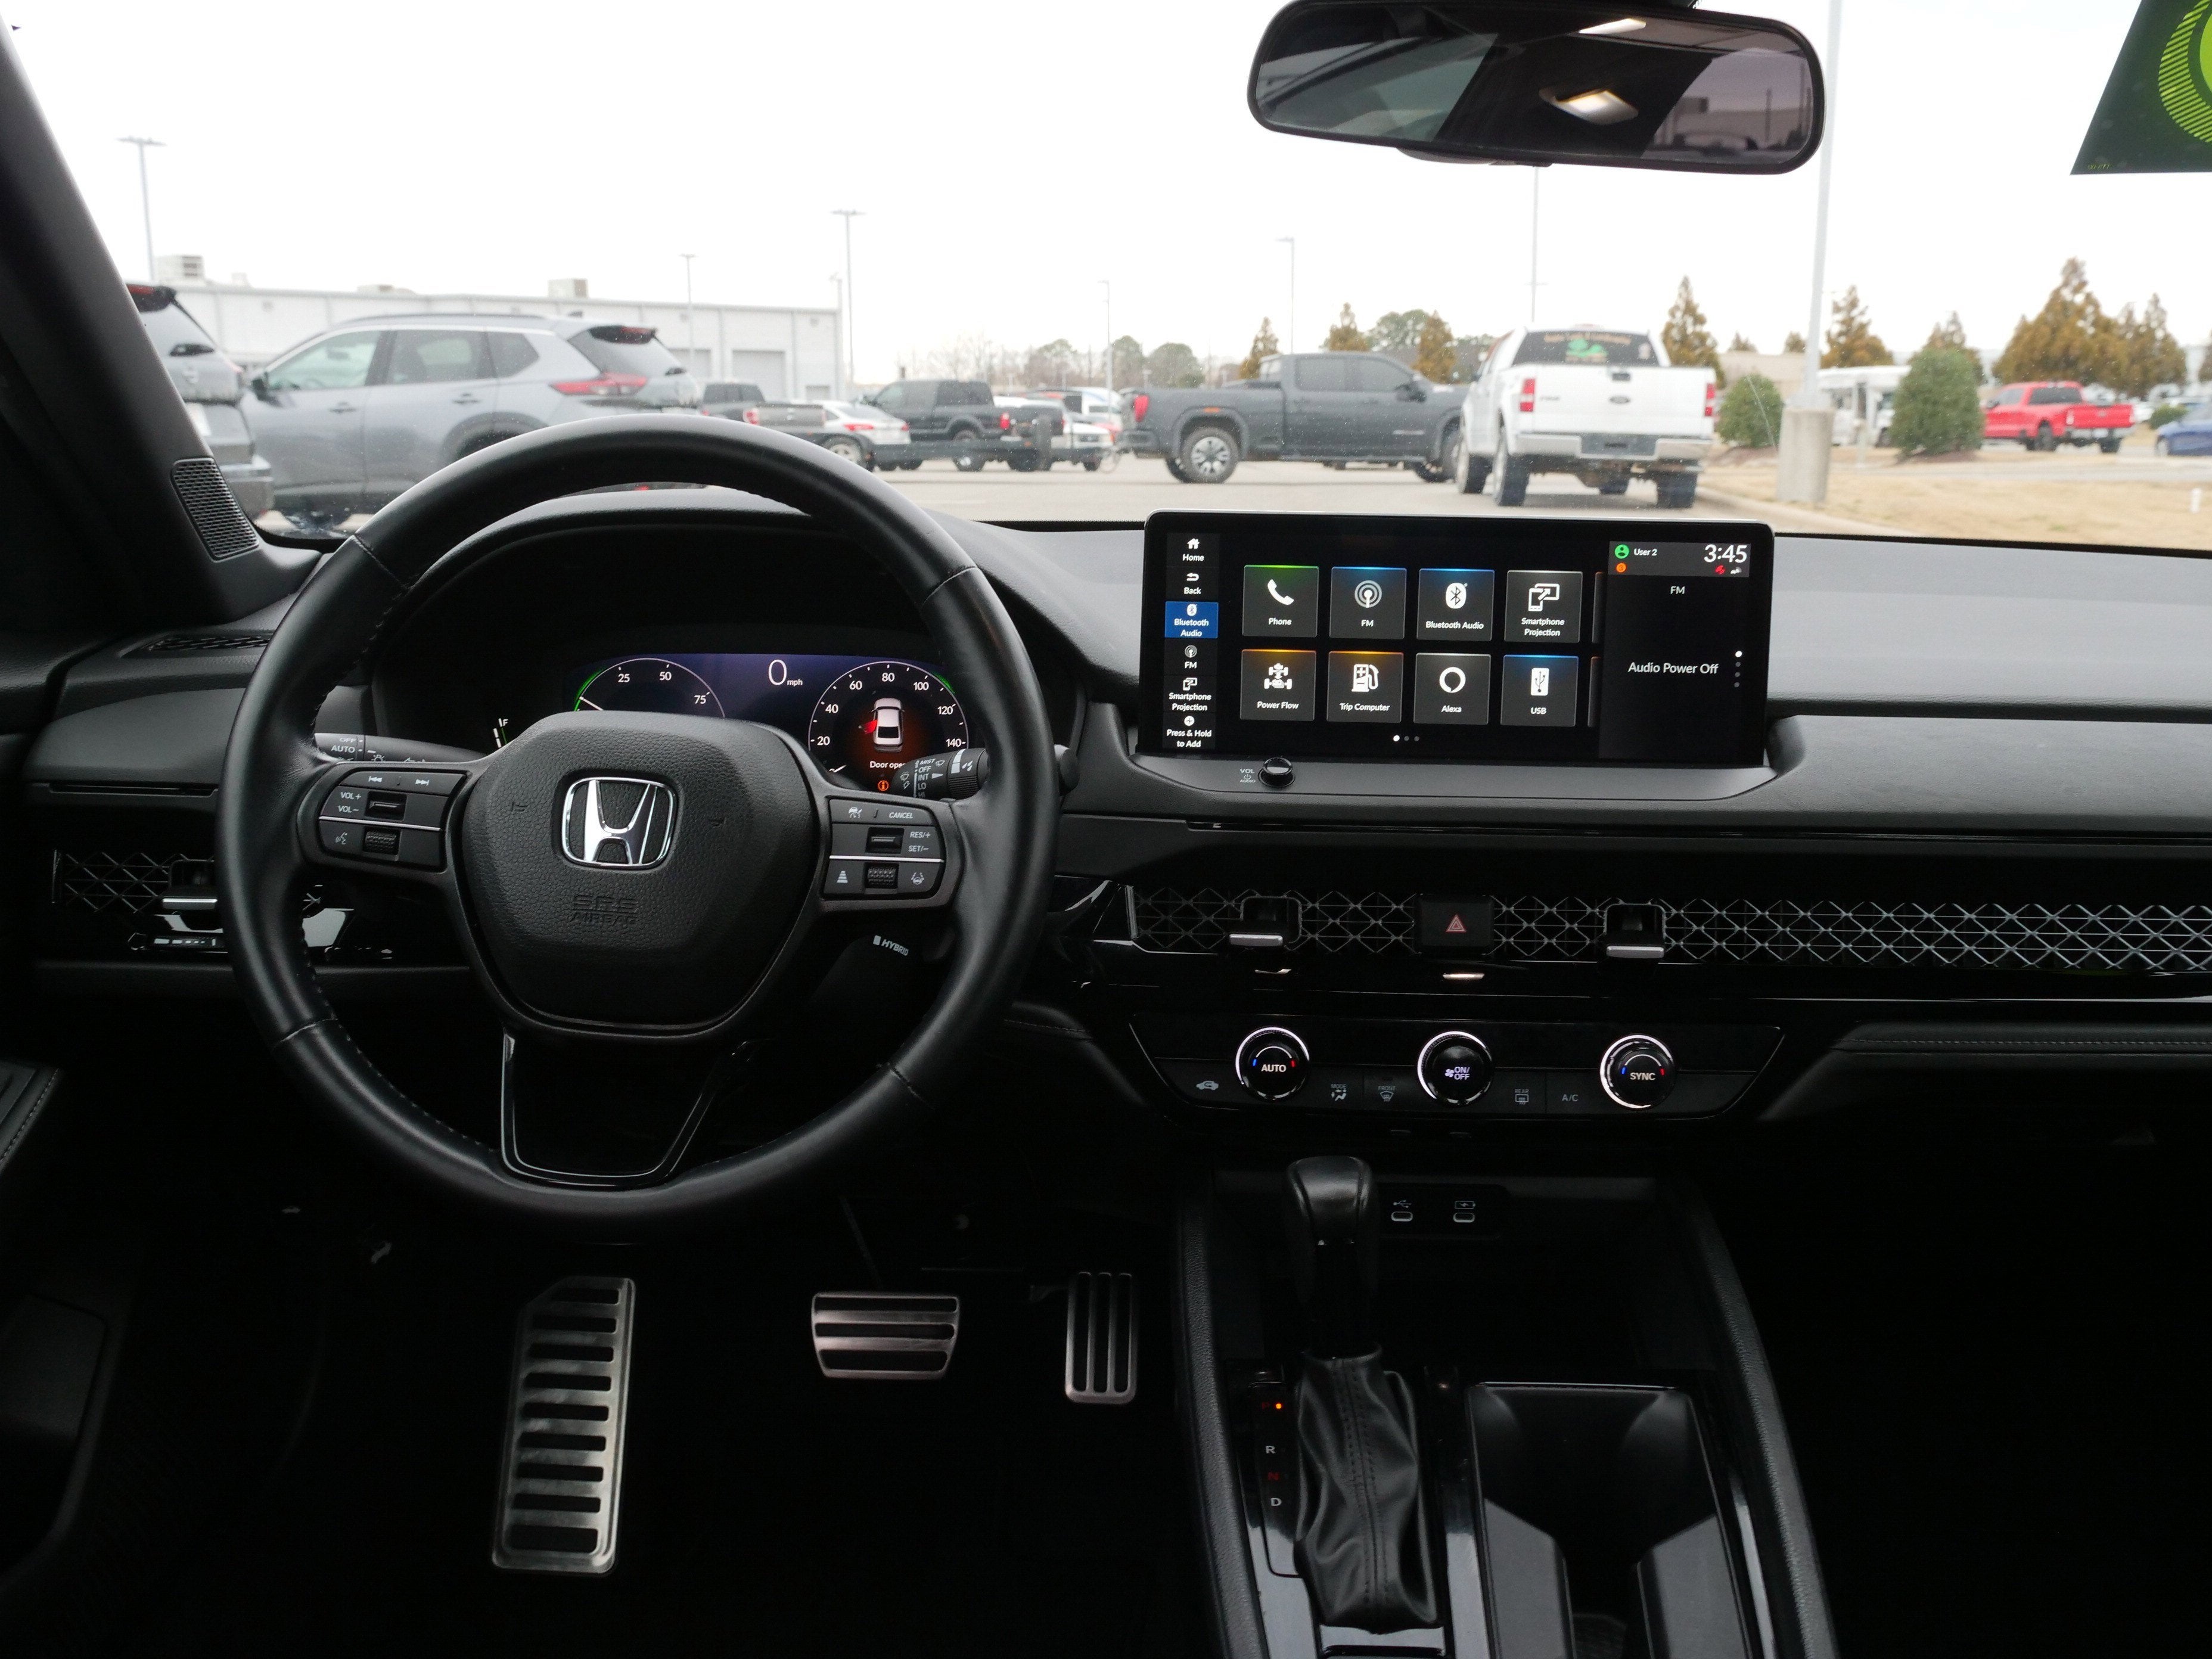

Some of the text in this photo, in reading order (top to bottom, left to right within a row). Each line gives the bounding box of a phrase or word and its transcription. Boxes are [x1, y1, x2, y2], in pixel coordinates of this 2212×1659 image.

[1633, 548, 1650, 556] User
[1704, 543, 1747, 563] 3:45
[1182, 553, 1205, 561] Home
[1183, 586, 1201, 595] Back
[1670, 586, 1685, 595] FM
[1174, 618, 1209, 626] Bluetooth
[1268, 617, 1292, 626] Phone
[1425, 620, 1484, 629] Bluetooth Audio
[1521, 617, 1565, 626] Smartphone
[1180, 629, 1203, 637] Audio
[1524, 628, 1561, 637] Projection
[1184, 661, 1197, 669] FM
[1627, 661, 1719, 674] Audio Power Off
[659, 671, 672, 681] 50
[768, 659, 803, 687] 0 mph
[881, 672, 895, 682] 80
[618, 673, 630, 683] 25
[849, 680, 863, 690] 60
[913, 681, 930, 691] 100
[694, 694, 706, 704] 75
[1169, 692, 1212, 701] Smartphone
[825, 704, 839, 714] 40
[937, 704, 952, 714] 120
[1172, 703, 1208, 712] Projection
[1257, 701, 1281, 709] Power
[1339, 703, 1390, 712] Trip Computer
[1441, 704, 1462, 713] Alexa
[1530, 707, 1547, 715] USB
[817, 736, 831, 746] 20
[946, 738, 961, 747] 140
[1185, 740, 1201, 748] Add
[331, 745, 355, 753] AUTO
[918, 782, 927, 790] LO
[881, 939, 909, 956] HYBRID
[1261, 1064, 1287, 1073] AUTO
[1630, 1072, 1655, 1080] SYNC
[1561, 1093, 1579, 1102] A/C
[1265, 1445, 1276, 1454] R
[1267, 1472, 1279, 1481] N
[1270, 1498, 1282, 1506] D
